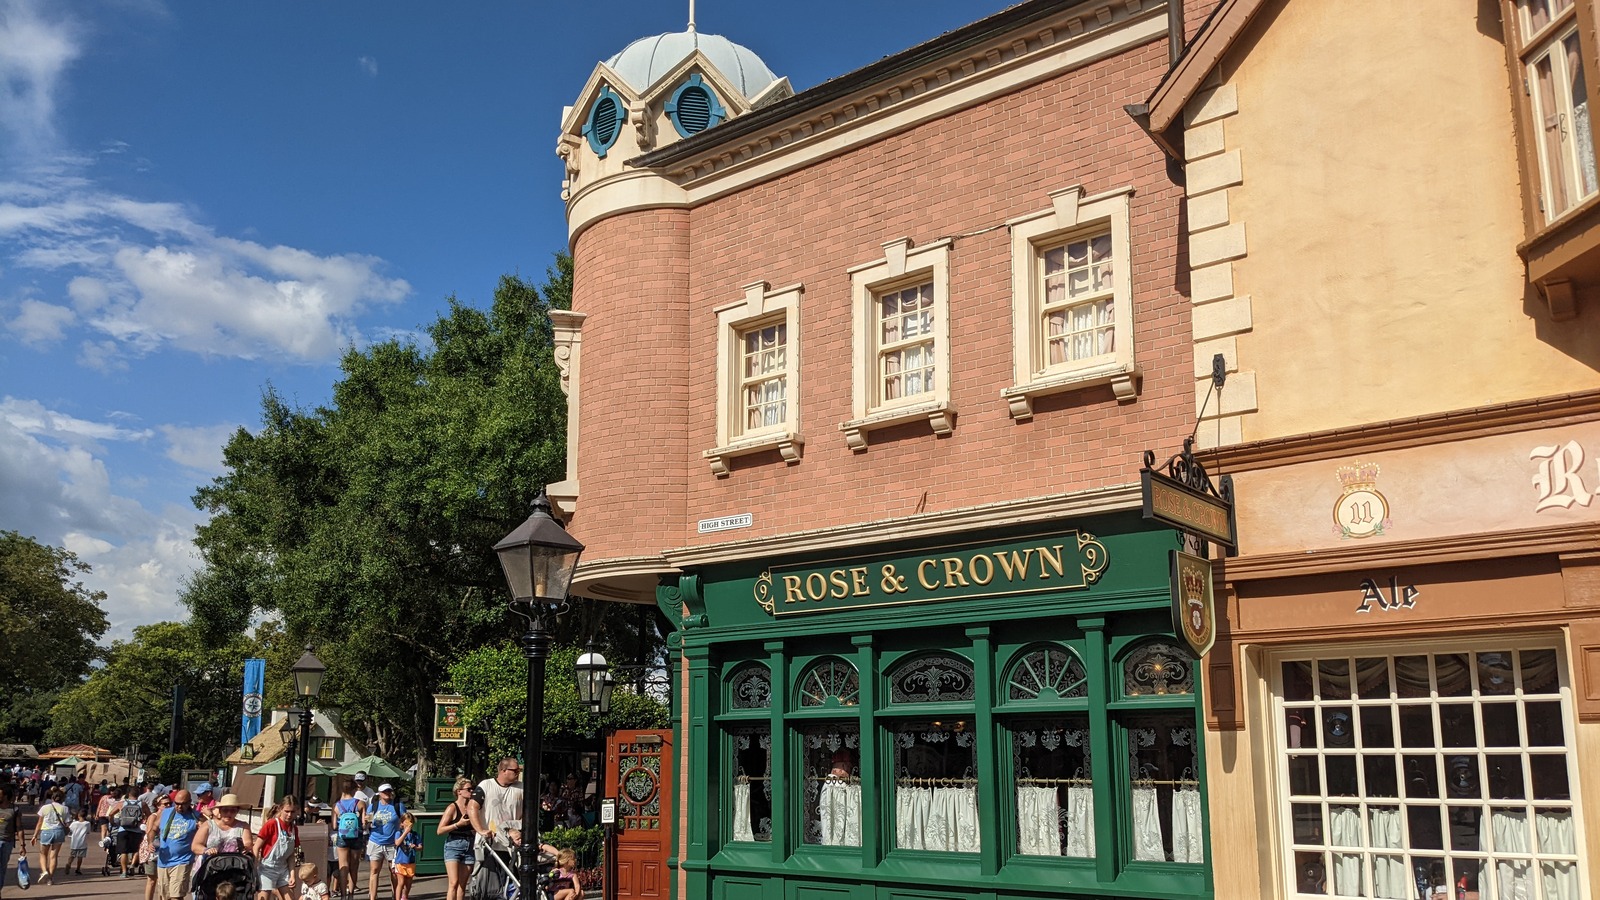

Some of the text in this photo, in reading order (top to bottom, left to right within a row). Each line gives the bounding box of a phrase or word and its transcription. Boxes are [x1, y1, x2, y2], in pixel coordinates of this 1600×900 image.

[1529, 440, 1600, 513] R
[720, 517, 749, 526] STREET
[1153, 485, 1227, 534] ROSE & CROWN
[782, 545, 1064, 603] ROSE & CROWN
[1356, 576, 1419, 613] Ale
